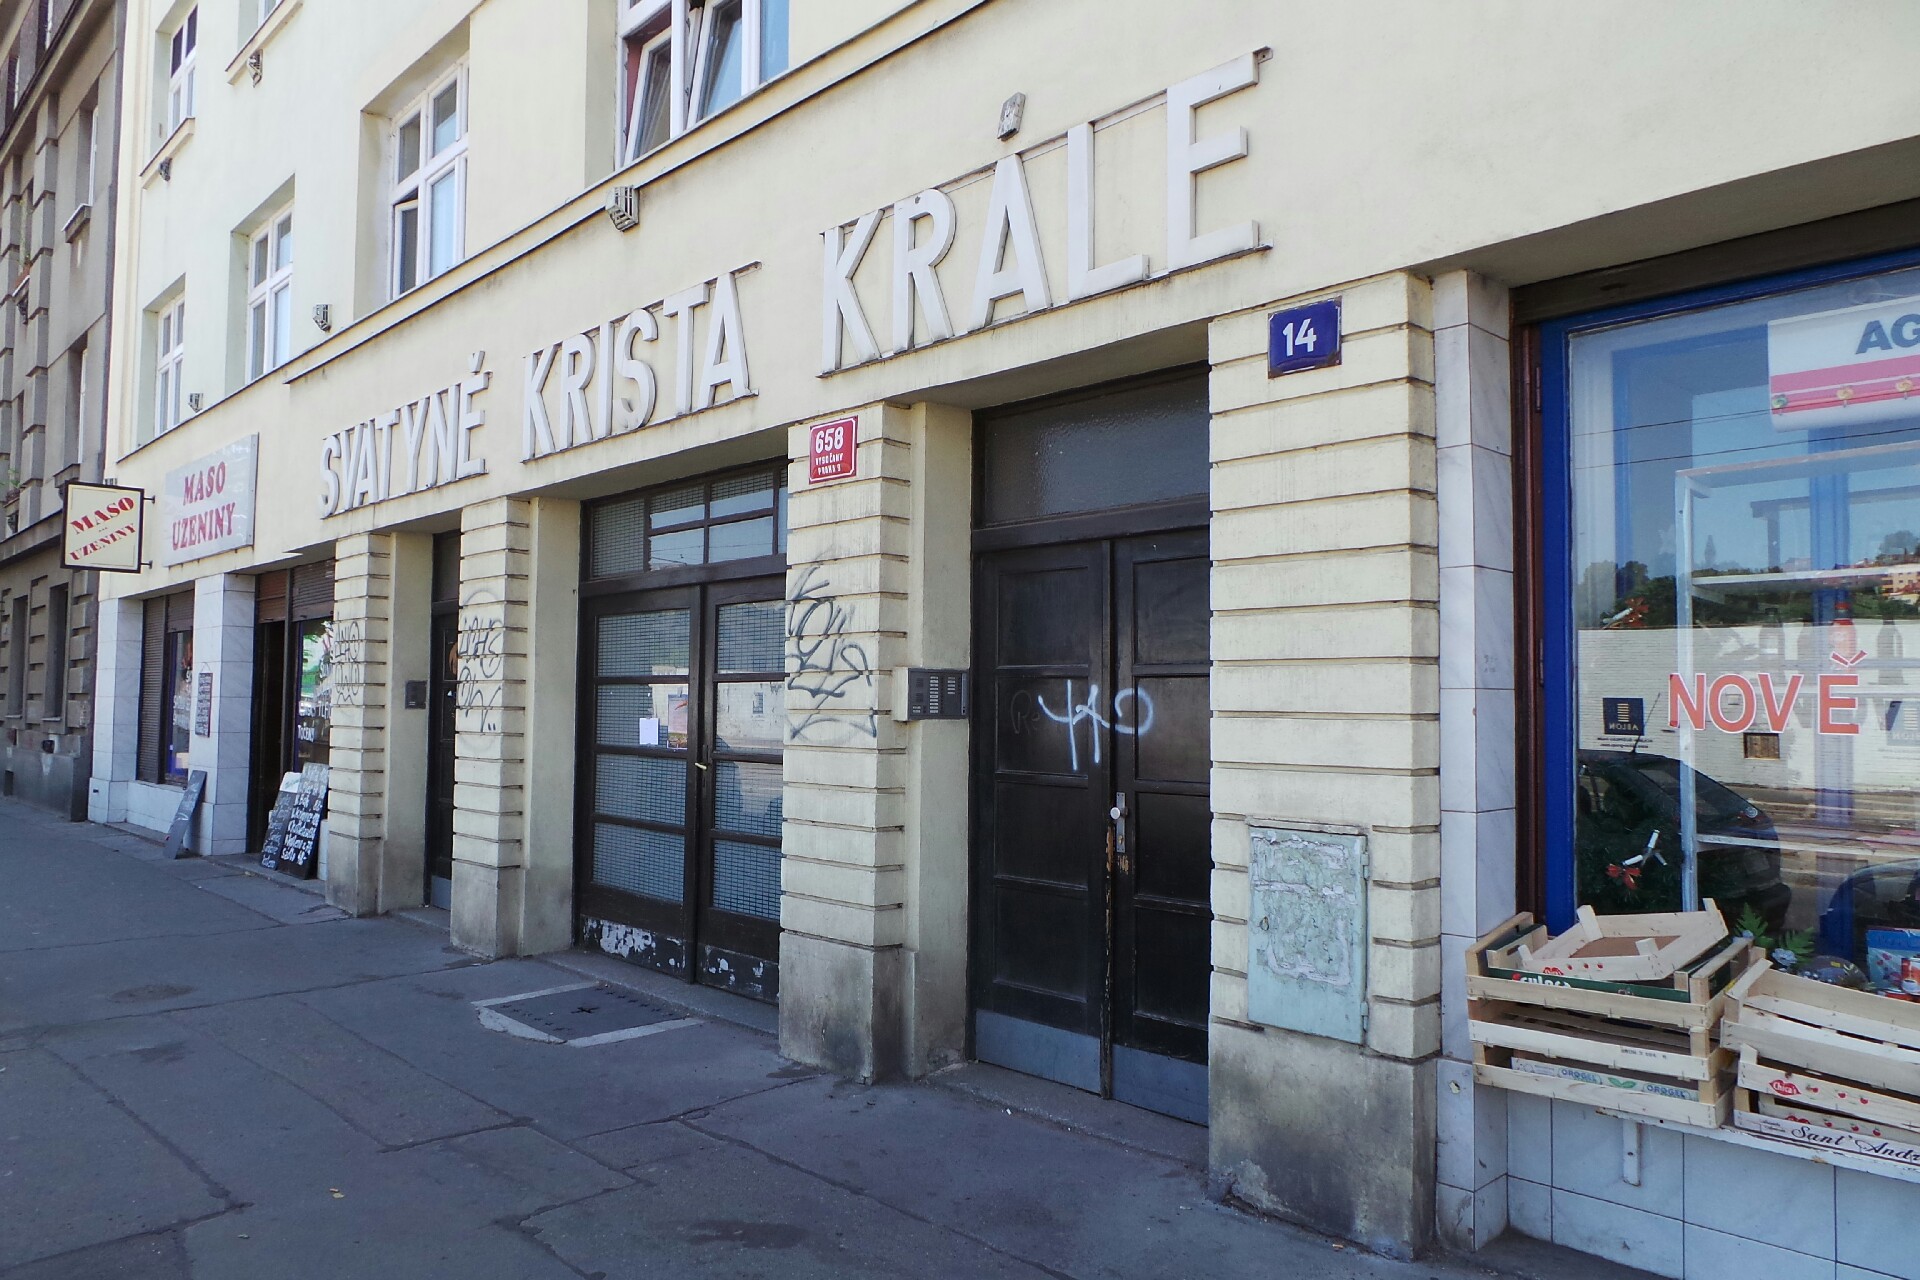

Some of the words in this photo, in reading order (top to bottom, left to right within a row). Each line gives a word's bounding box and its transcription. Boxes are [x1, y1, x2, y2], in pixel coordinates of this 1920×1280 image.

[320, 351, 490, 517] SVATYNĚ
[523, 272, 750, 460] KRISTA
[822, 51, 1259, 374] KRÁLE
[1282, 318, 1317, 356] 14
[1855, 313, 1920, 355] AG
[815, 426, 844, 453] 658
[183, 461, 226, 506] MASO
[70, 497, 135, 535] MASO
[172, 502, 236, 550] UZENINY
[69, 523, 136, 561] UZENINY
